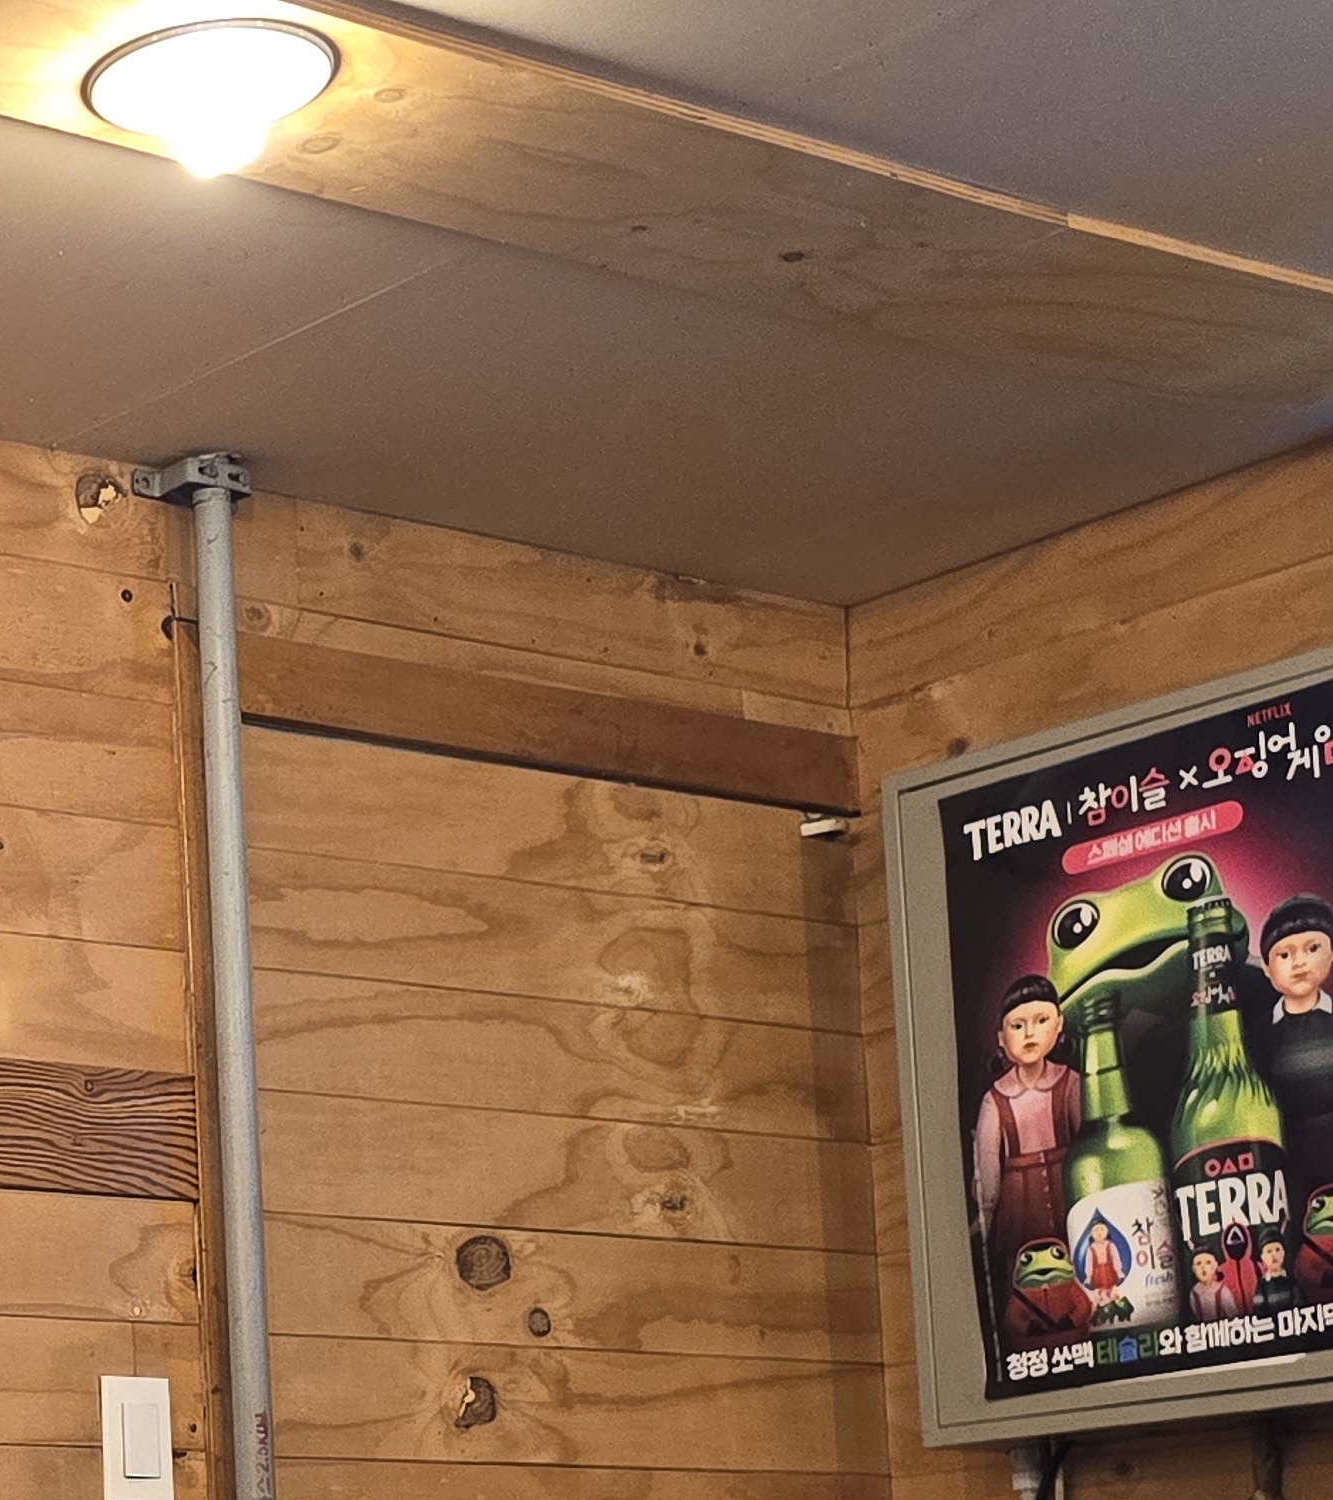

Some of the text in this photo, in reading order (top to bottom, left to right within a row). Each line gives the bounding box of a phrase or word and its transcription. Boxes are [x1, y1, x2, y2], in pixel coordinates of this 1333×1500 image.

[1247, 702, 1293, 728] NETFLIX
[963, 799, 1062, 861] TERRA
[1078, 767, 1171, 826] 참이슬
[1192, 944, 1232, 971] TERRA
[1174, 1169, 1292, 1241] TERRA
[1184, 1315, 1275, 1354] 함께하는
